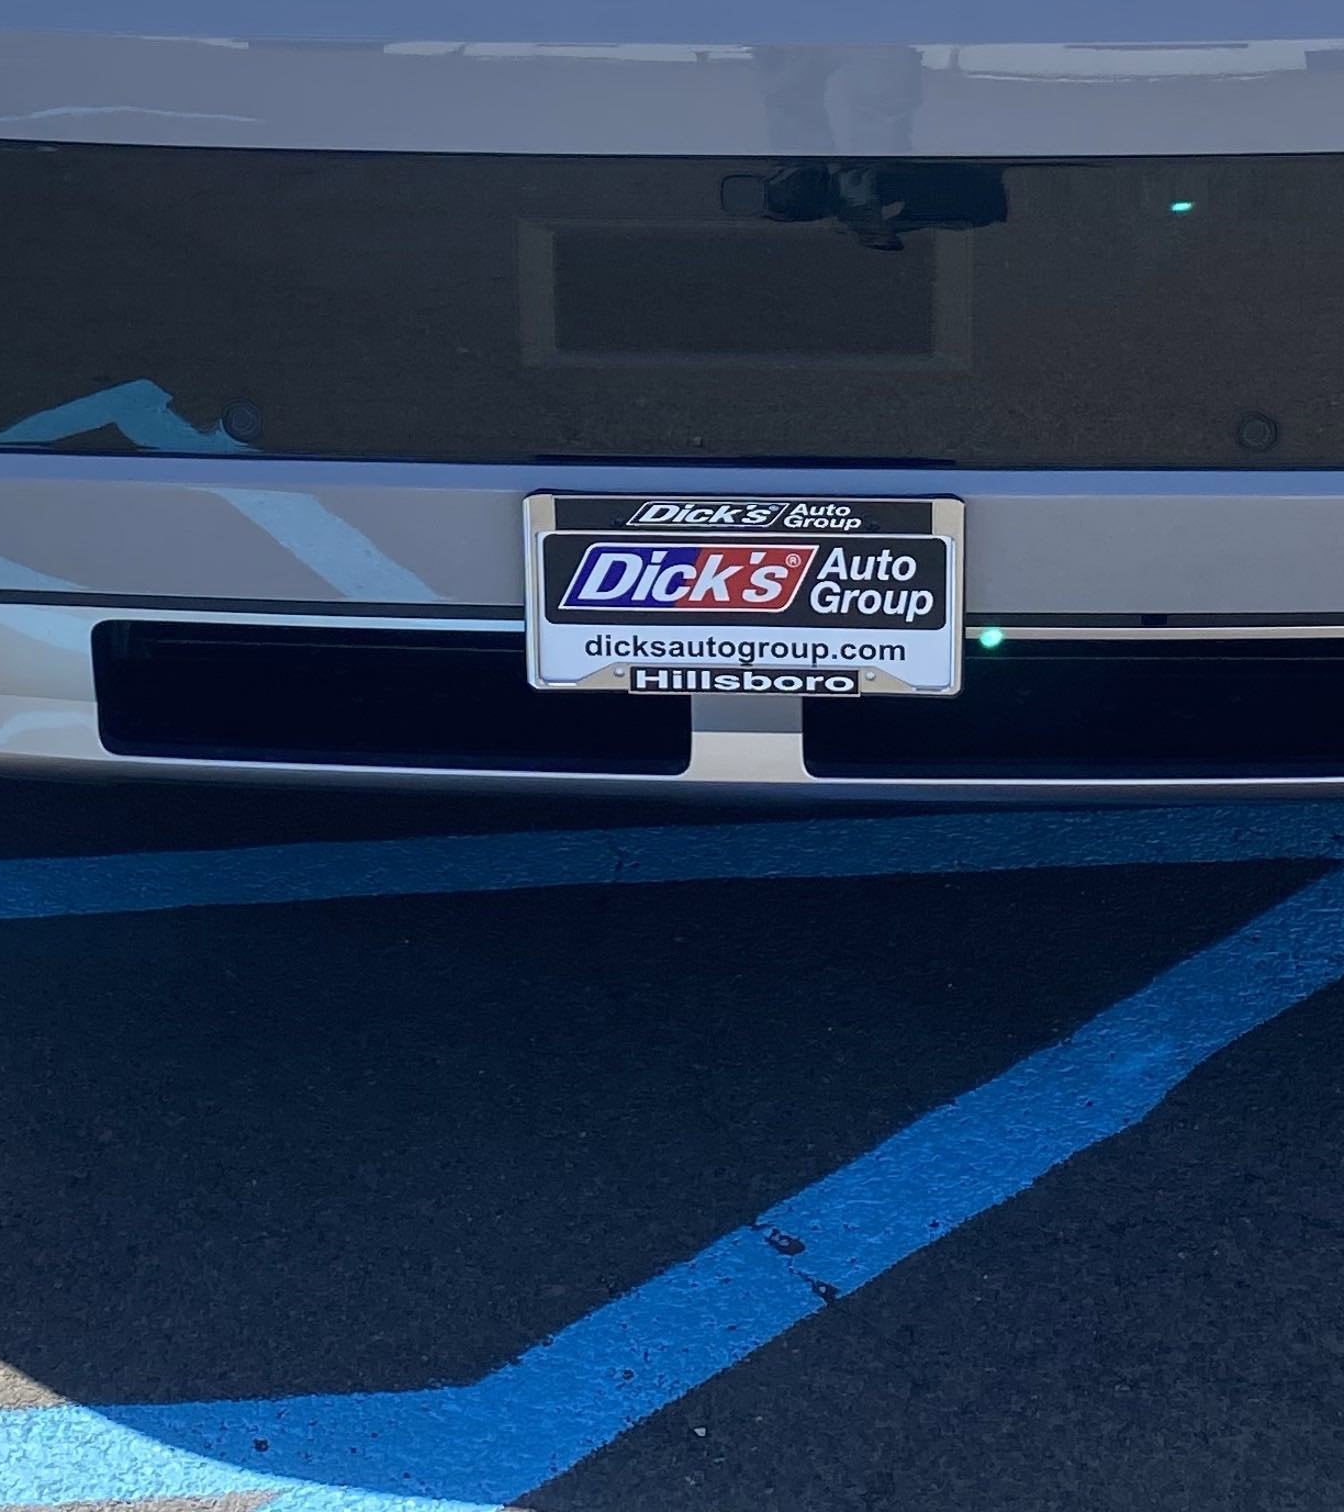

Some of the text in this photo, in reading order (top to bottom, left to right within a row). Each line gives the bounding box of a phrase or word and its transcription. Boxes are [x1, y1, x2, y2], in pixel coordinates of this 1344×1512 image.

[783, 515, 862, 531] Group
[789, 502, 851, 517] Auto
[577, 550, 789, 603] Dick's
[816, 547, 917, 581] Auto
[810, 580, 934, 623] Group
[584, 635, 906, 667] dicksautogroup.com
[635, 669, 855, 693] Hillsboro
